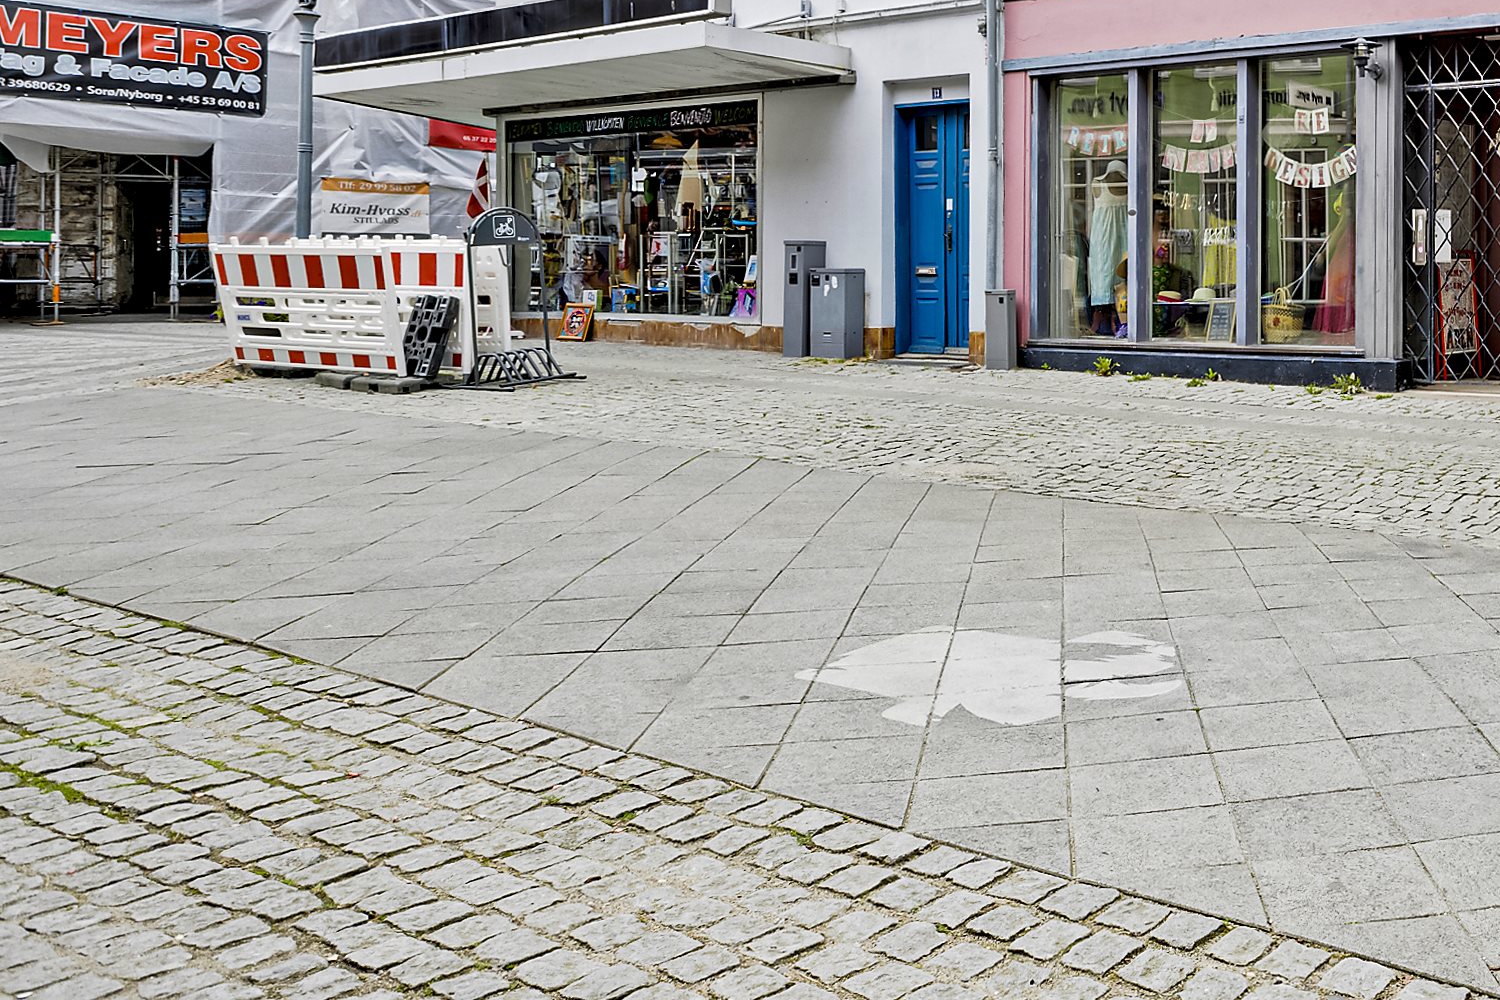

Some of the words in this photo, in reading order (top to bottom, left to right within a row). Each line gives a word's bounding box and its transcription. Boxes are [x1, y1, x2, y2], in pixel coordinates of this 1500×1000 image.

[0, 4, 262, 73] MEYERS
[54, 53, 85, 77] &
[90, 57, 207, 88] Facade
[213, 71, 262, 94] A/S
[7, 78, 71, 93] 39680629
[87, 85, 164, 103] Sorø/Nyborg
[178, 95, 200, 106] +45
[201, 97, 216, 107] 53
[217, 98, 232, 108] 69
[233, 99, 247, 110] 00
[248, 100, 261, 111] 81
[1297, 111, 1326, 132] RE
[337, 181, 356, 190] Tlf:
[359, 182, 373, 191] 29
[374, 182, 388, 192] 99
[403, 185, 417, 193] 02
[352, 216, 400, 226] STILLADS
